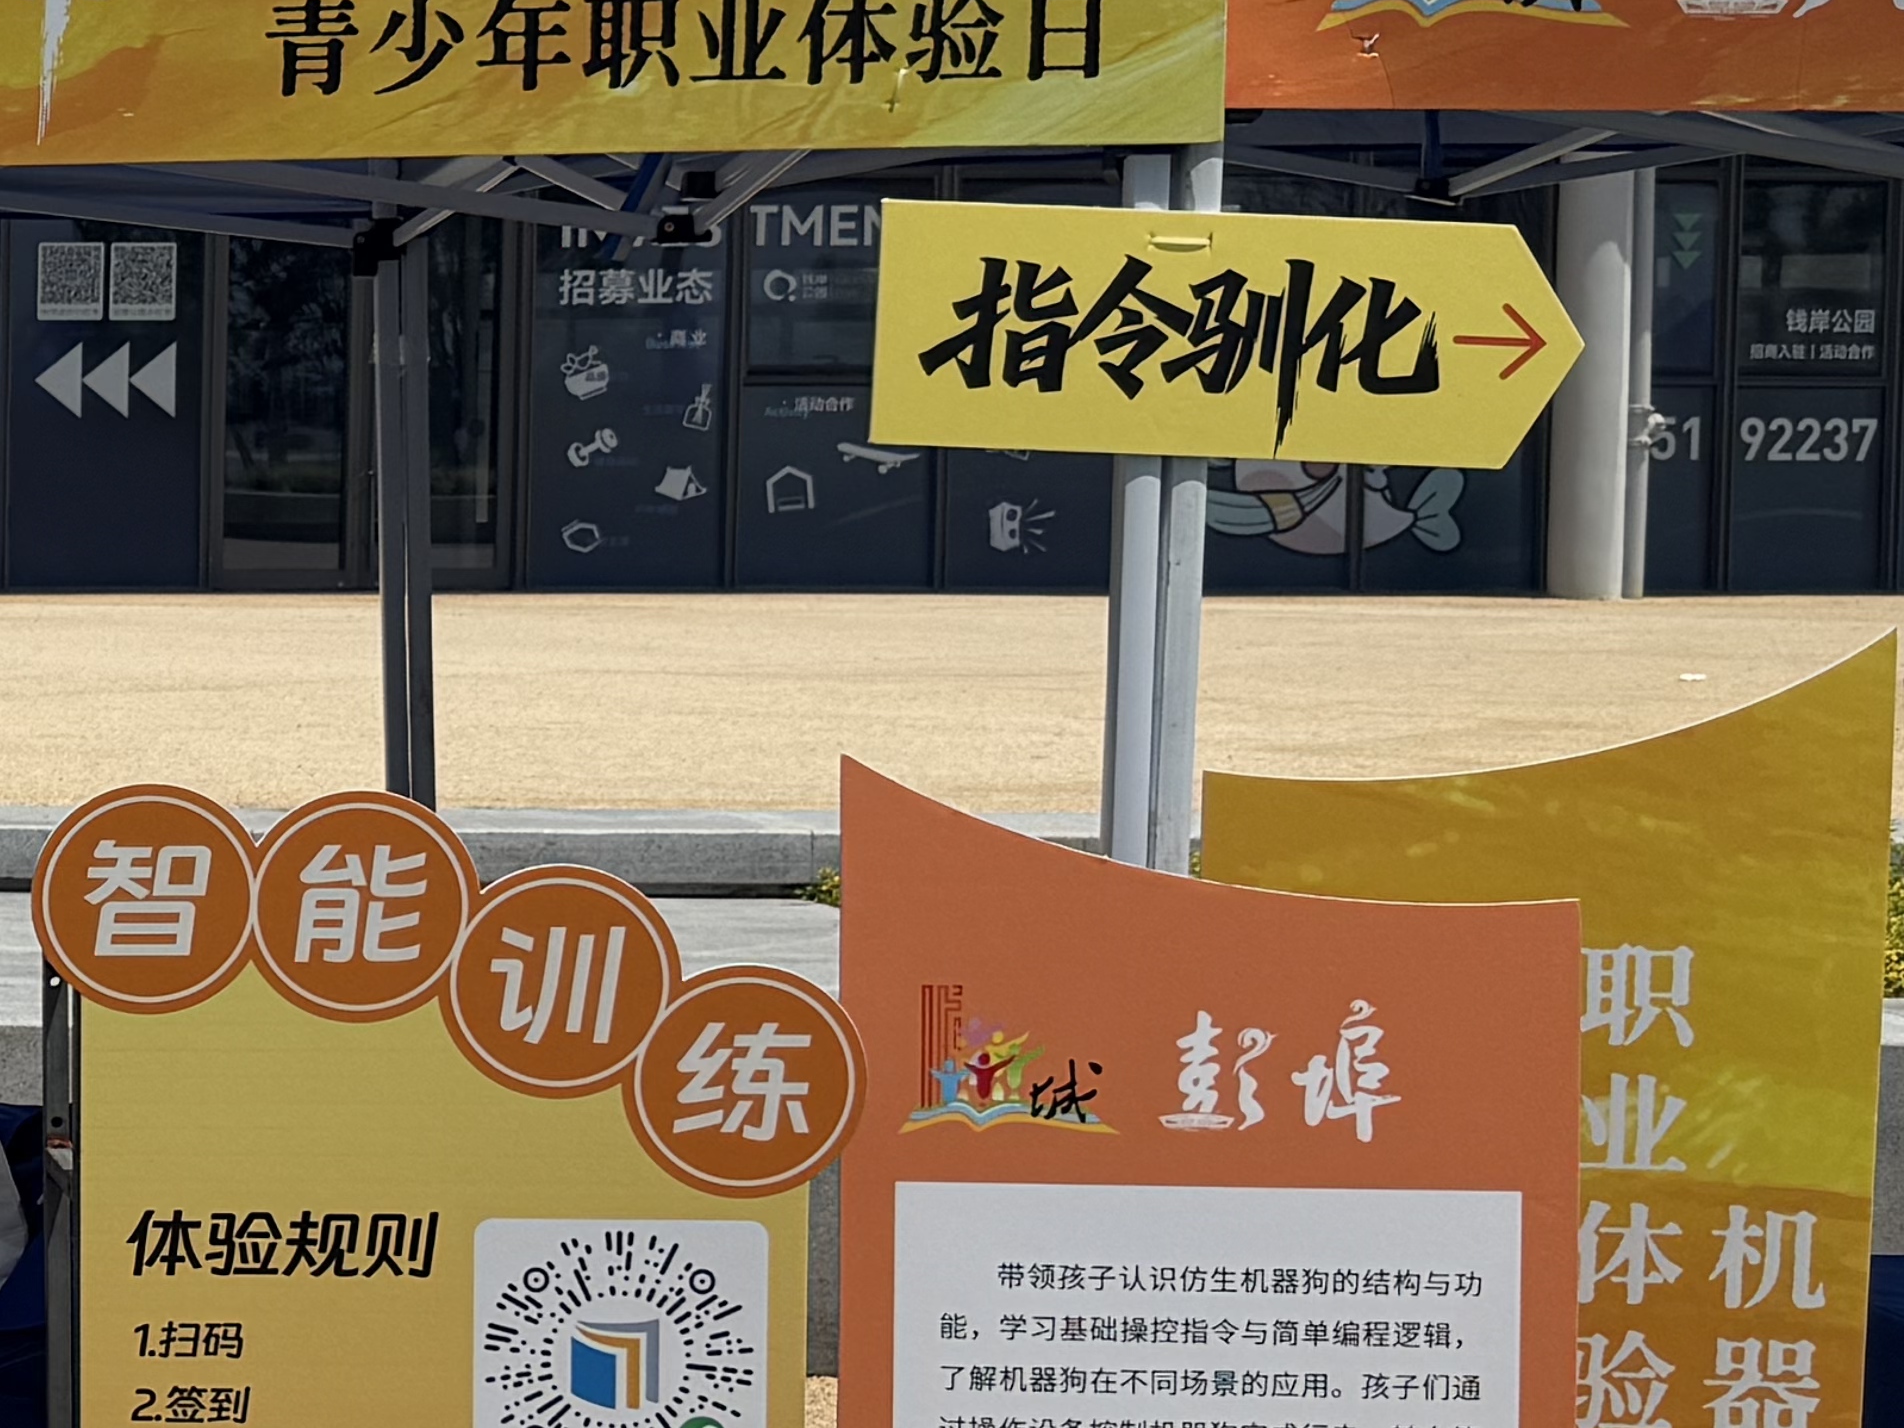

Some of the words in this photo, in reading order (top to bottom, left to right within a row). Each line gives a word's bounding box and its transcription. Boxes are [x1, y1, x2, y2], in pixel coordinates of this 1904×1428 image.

[558, 269, 714, 306] 招募业态
[917, 253, 1440, 459] 指令驯化
[1739, 416, 1878, 461] 92237
[83, 838, 811, 1142] 智能训练
[1157, 998, 1402, 1143] 彭埠
[126, 1209, 441, 1279] 体验规则
[997, 1262, 1484, 1299] 带领孩子认识仿生机器狗的结构与功
[132, 1322, 245, 1360] 1.扫码
[939, 1312, 1465, 1351] 能，学习基础操控指令与简单编程逻辑，
[939, 1364, 1482, 1403] 了解机器狗在不同场景的应用。孩子们通
[130, 1385, 251, 1425] 2.签到
